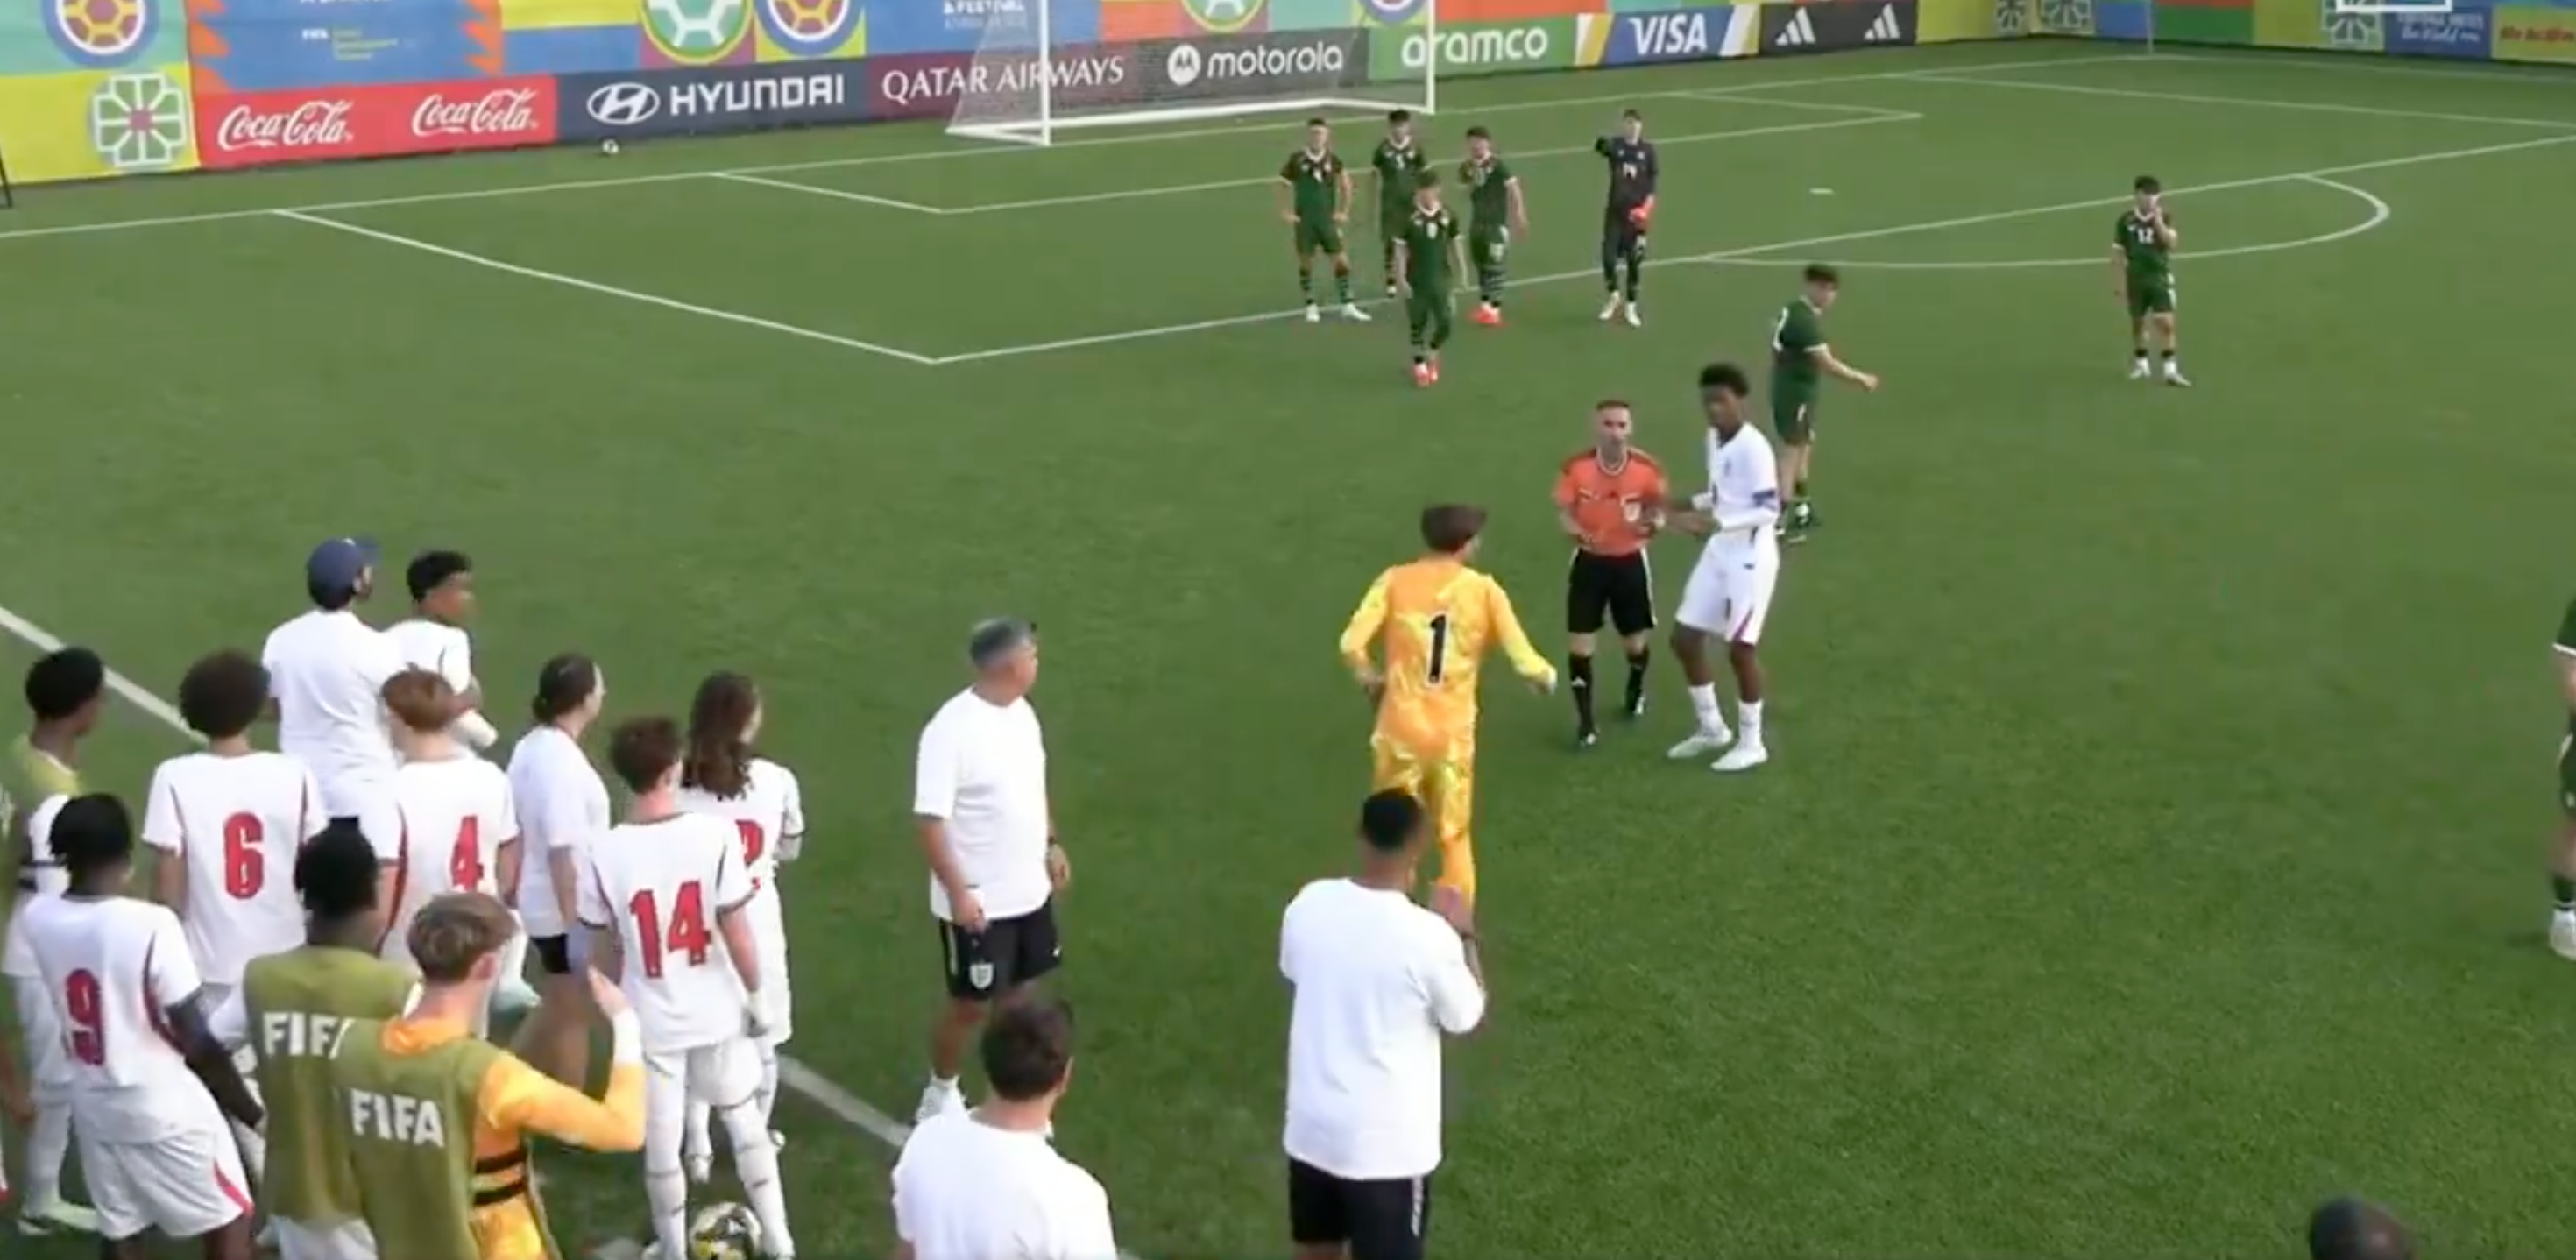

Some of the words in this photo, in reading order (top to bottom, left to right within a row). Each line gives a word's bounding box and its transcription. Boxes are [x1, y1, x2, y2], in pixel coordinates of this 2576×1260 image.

[1207, 40, 1344, 80] motorola
[1401, 27, 1548, 67] aramco
[1628, 13, 1707, 55] VISA
[669, 74, 844, 117] HYUNDAI
[881, 65, 989, 105] QATAR
[996, 55, 1125, 93] AIRWAYS
[1427, 613, 1447, 684] 1
[223, 811, 265, 900] 6
[449, 815, 484, 892] 4
[628, 880, 711, 980] 14
[65, 967, 106, 1067] 9
[263, 1010, 356, 1060] FIF
[350, 1087, 445, 1149] FIFA
